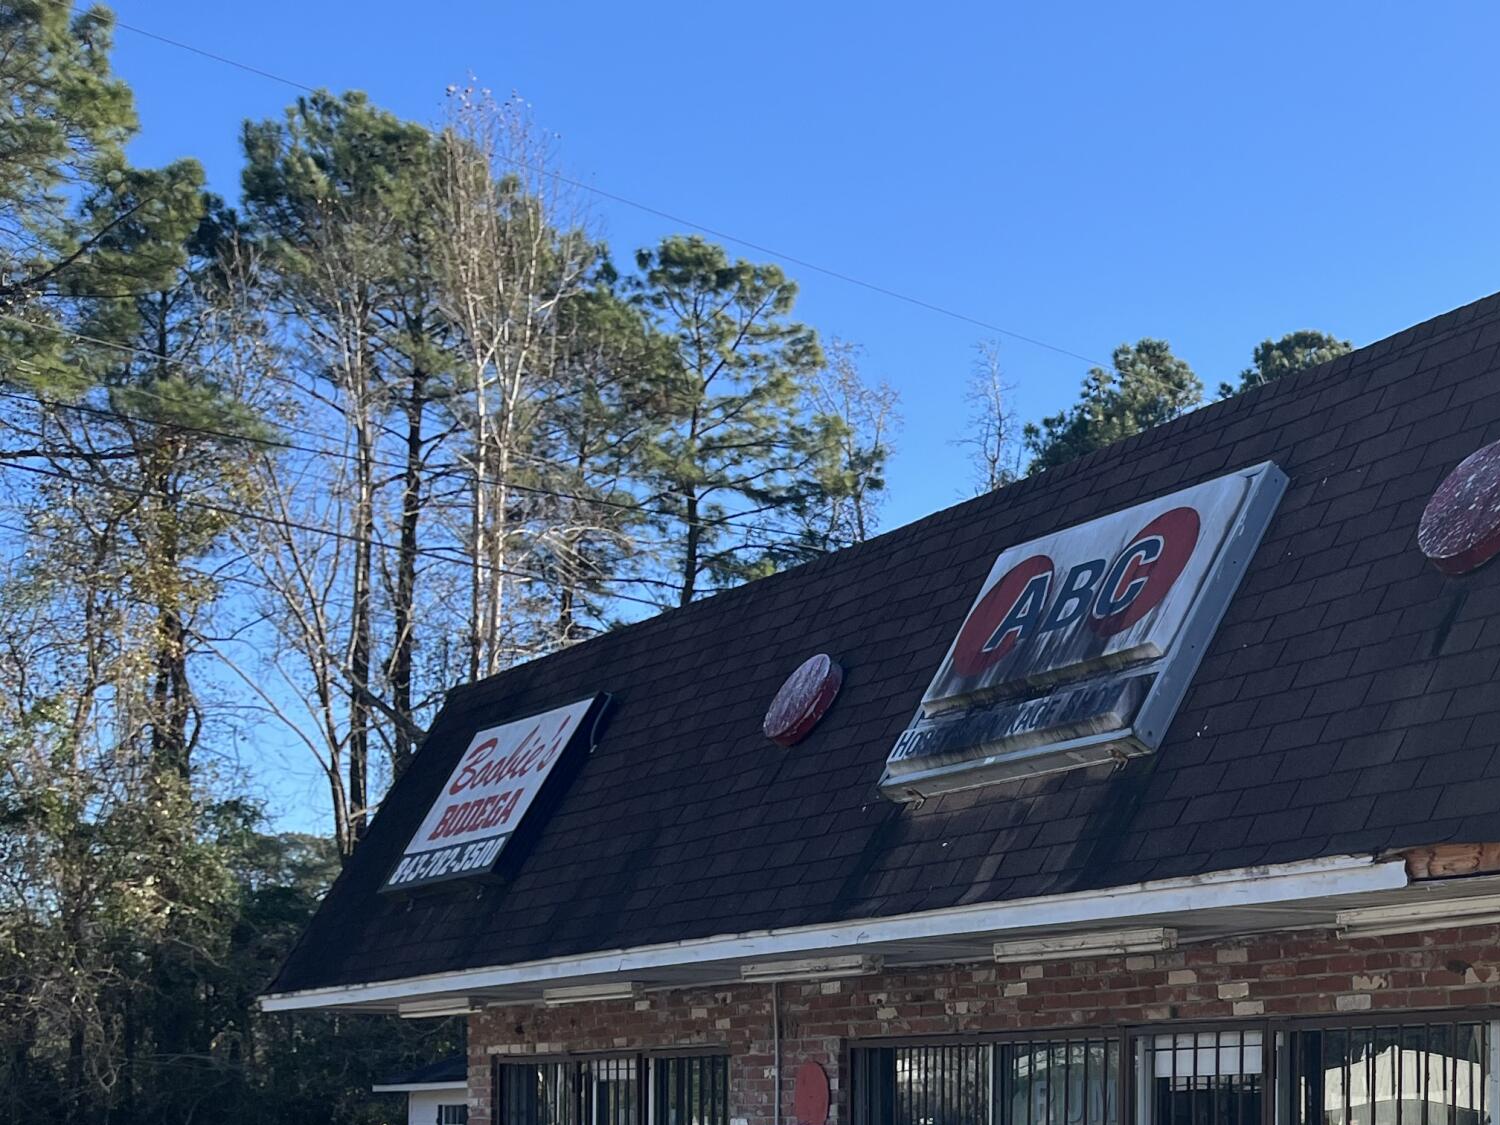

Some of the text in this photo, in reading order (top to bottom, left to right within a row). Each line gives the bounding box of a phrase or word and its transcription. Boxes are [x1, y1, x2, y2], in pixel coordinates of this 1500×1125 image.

[980, 533, 1166, 653] ABC
[449, 715, 572, 795] Boobie's
[427, 788, 525, 841] BODEGA
[388, 837, 506, 885] 843-782-3500
